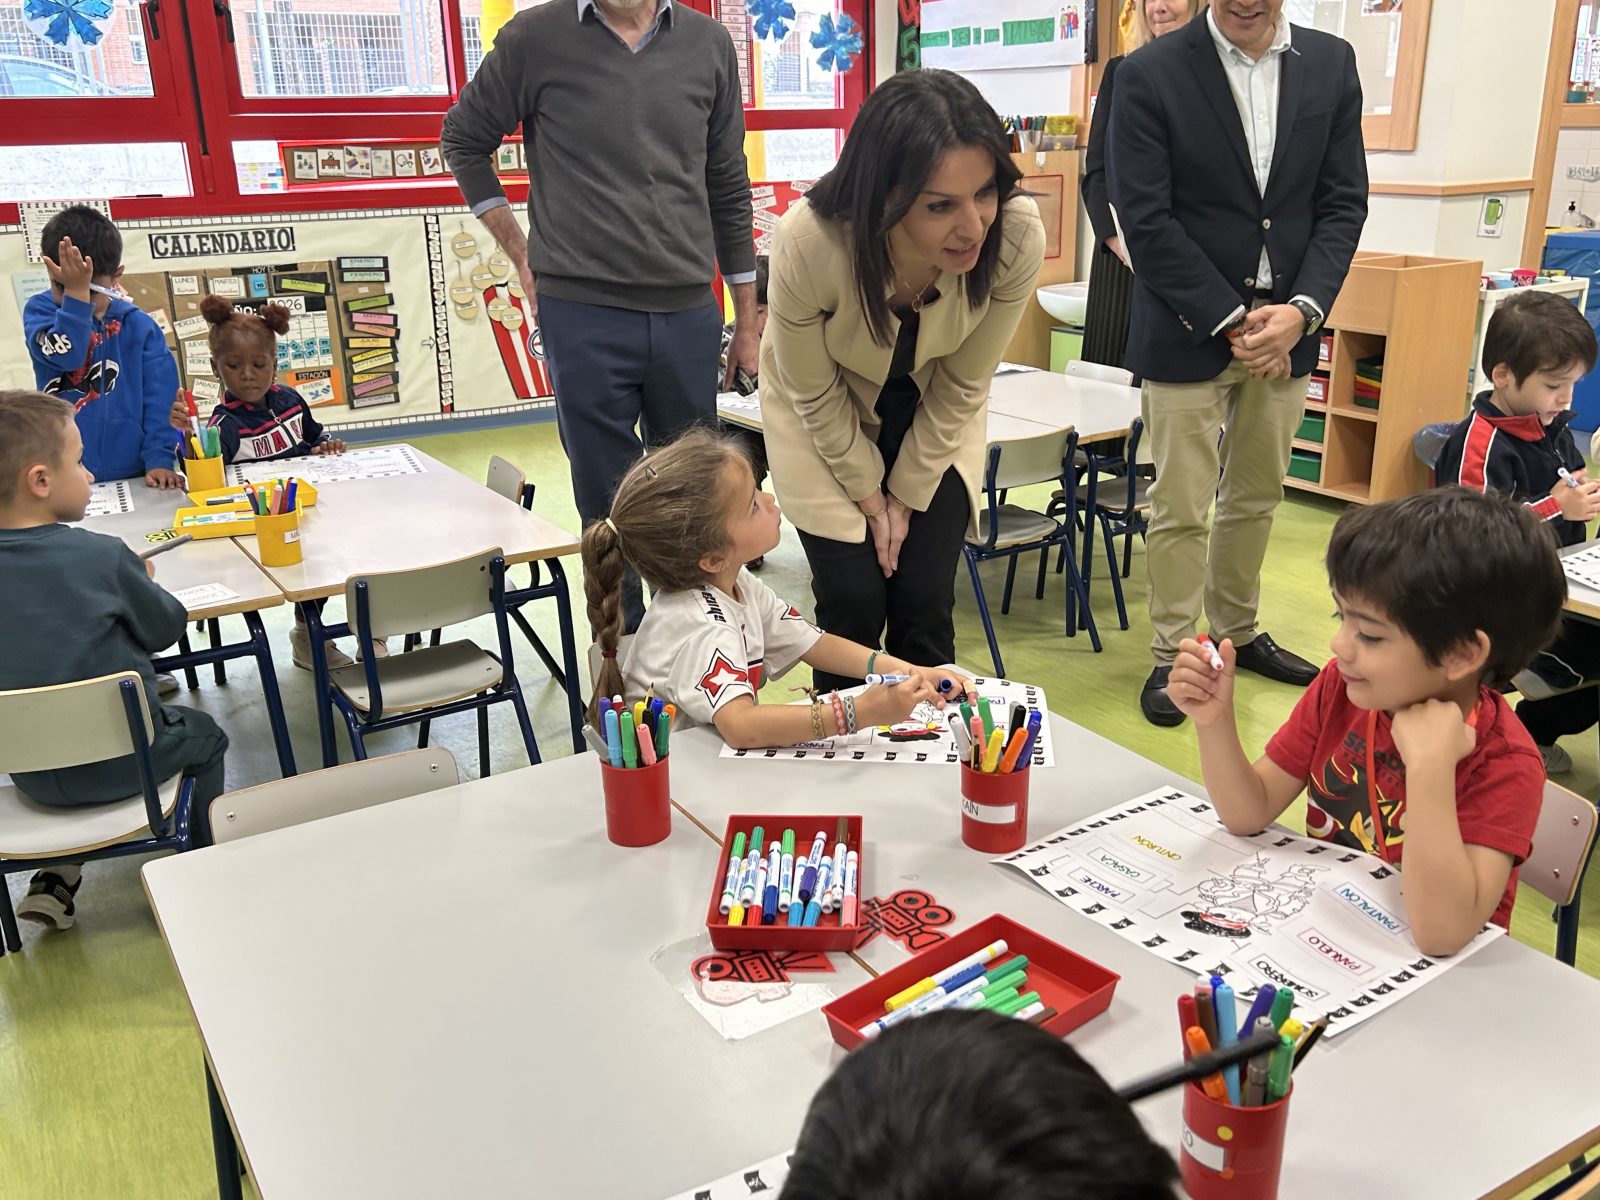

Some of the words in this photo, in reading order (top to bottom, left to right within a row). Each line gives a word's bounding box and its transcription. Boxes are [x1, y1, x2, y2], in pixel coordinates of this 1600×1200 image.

[902, 27, 920, 70] 5
[153, 228, 291, 257] CALENDARIO
[174, 275, 195, 283] LUNES
[252, 266, 266, 274] HOY
[232, 304, 257, 316] ÑO:
[298, 371, 329, 380] ESTACIÓN
[1100, 854, 1141, 878] CASACA
[1080, 875, 1121, 898] PARCHE
[1308, 936, 1362, 971] PAÑUELO
[1256, 960, 1319, 998] SOMBRERO
